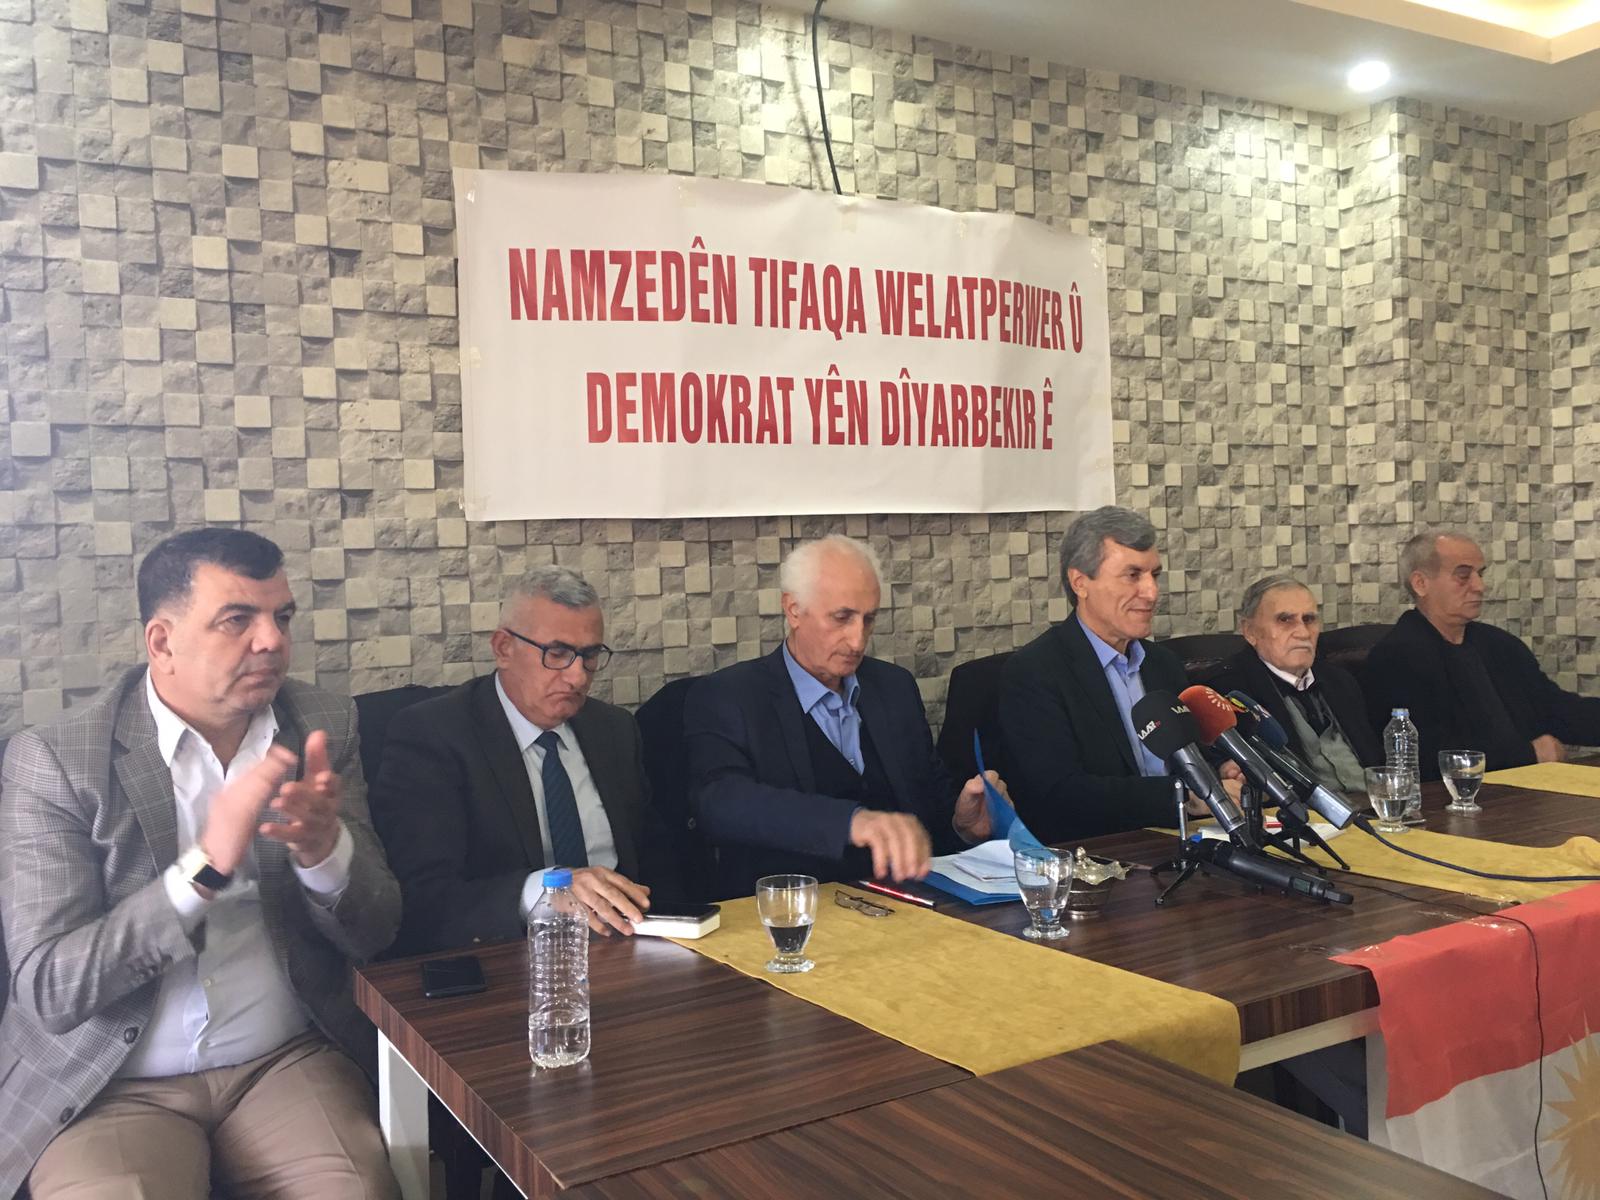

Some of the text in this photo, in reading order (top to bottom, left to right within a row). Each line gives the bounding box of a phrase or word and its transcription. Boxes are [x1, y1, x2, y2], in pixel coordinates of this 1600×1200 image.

[507, 235, 1084, 354] NAMZEDÊN TIFAQA WELATPERWER Û
[585, 363, 1054, 451] DEMOKRAT YÊN DÎYARBEKIR Ê
